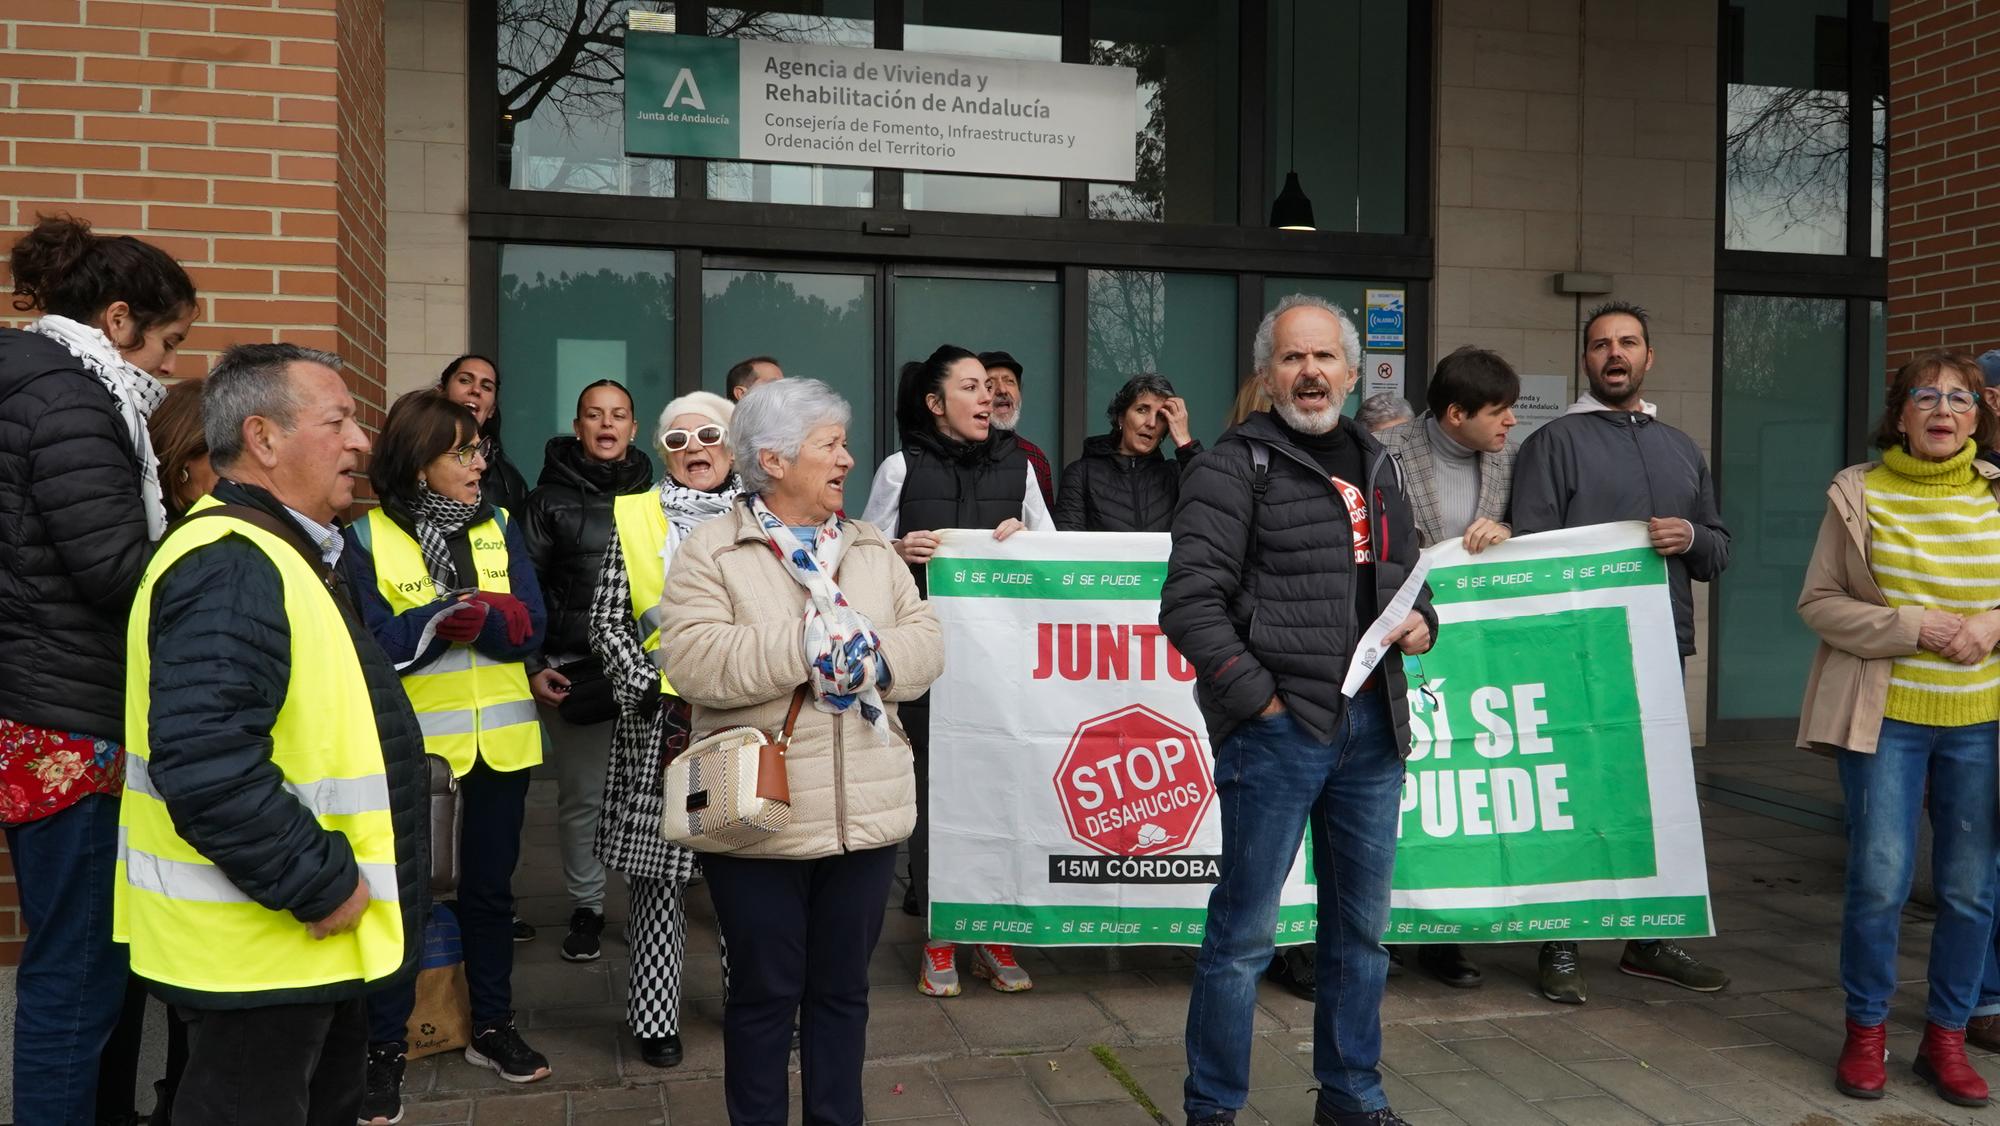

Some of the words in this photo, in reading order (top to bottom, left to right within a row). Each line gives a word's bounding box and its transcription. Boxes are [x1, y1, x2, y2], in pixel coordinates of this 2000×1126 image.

[765, 56, 847, 79] Agencia
[853, 62, 878, 80] de
[883, 64, 971, 87] Vivienda
[977, 75, 988, 92] y
[766, 83, 916, 110] Rehabilitación
[922, 93, 946, 112] de
[952, 96, 1050, 118] Andalucía
[637, 111, 665, 121] Junta
[667, 112, 679, 122] de
[681, 113, 729, 125] Andalucía
[765, 113, 845, 132] Consejería
[850, 118, 868, 132] de
[873, 120, 943, 140] Fomento,
[949, 125, 1063, 145] Infraestructuras
[1067, 135, 1075, 148] y
[765, 133, 854, 152] Ordenación
[858, 139, 881, 153] del
[886, 141, 956, 157] Territorio
[954, 571, 966, 583] SÍ
[971, 572, 986, 583] SE
[992, 573, 1033, 584] PUEDE
[1062, 573, 1075, 585] SÍ
[1080, 574, 1095, 586] SE
[1101, 575, 1141, 586] PUEDE
[1457, 576, 1468, 589] SÍ
[1472, 576, 1486, 588] SE
[1492, 572, 1533, 586] PUEDE
[1562, 567, 1574, 580] SÍ
[1580, 567, 1596, 579] SE
[1601, 561, 1642, 575] PUEDE
[1032, 623, 1197, 682] JUNTO
[1470, 683, 1554, 758] SE
[1071, 737, 1186, 810] STOP
[1085, 782, 1201, 838] DESAHUCIOS
[1397, 763, 1575, 839] PUEDE
[1057, 859, 1099, 877] 15M
[1106, 856, 1220, 878] CÓRDOBA
[954, 918, 966, 931] SÍ
[971, 921, 988, 931] SE
[993, 921, 1034, 934] PUEDE
[1062, 921, 1074, 933] SÍ
[1079, 922, 1094, 933] SE
[1100, 922, 1141, 934] PUEDE
[1170, 922, 1182, 933] SÍ
[1187, 923, 1203, 934] SE
[1276, 920, 1286, 933] SÍ
[1291, 921, 1305, 932] SE
[1397, 923, 1412, 933] SE
[1419, 923, 1462, 934] PUEDE
[1491, 922, 1502, 933] SÍ
[1507, 921, 1523, 932] SE
[1529, 918, 1571, 930] PUEDE
[1602, 915, 1614, 927] SÍ
[1620, 915, 1636, 927] SE
[1641, 914, 1686, 926] PUEDE
